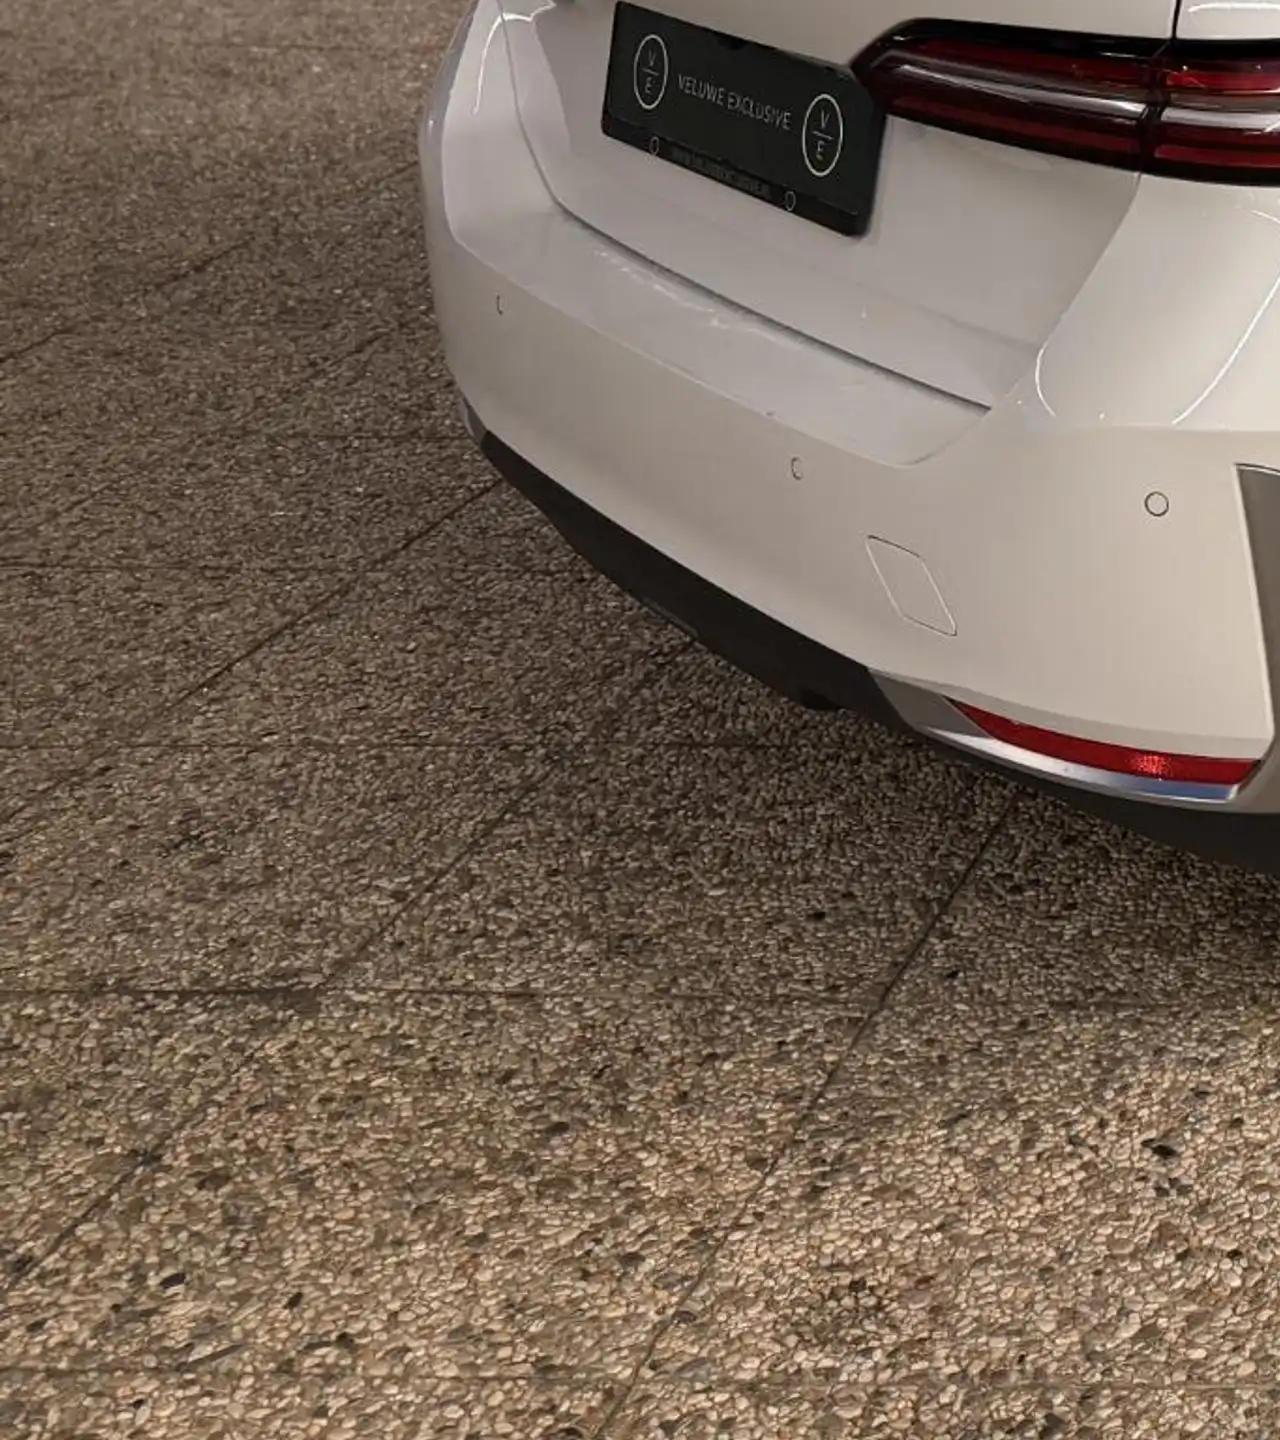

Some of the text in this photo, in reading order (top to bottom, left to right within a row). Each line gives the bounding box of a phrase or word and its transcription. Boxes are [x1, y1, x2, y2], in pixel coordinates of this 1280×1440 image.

[678, 74, 792, 131] VELUWE EXCLUSIVE
[819, 109, 830, 128] V
[815, 140, 826, 160] E
